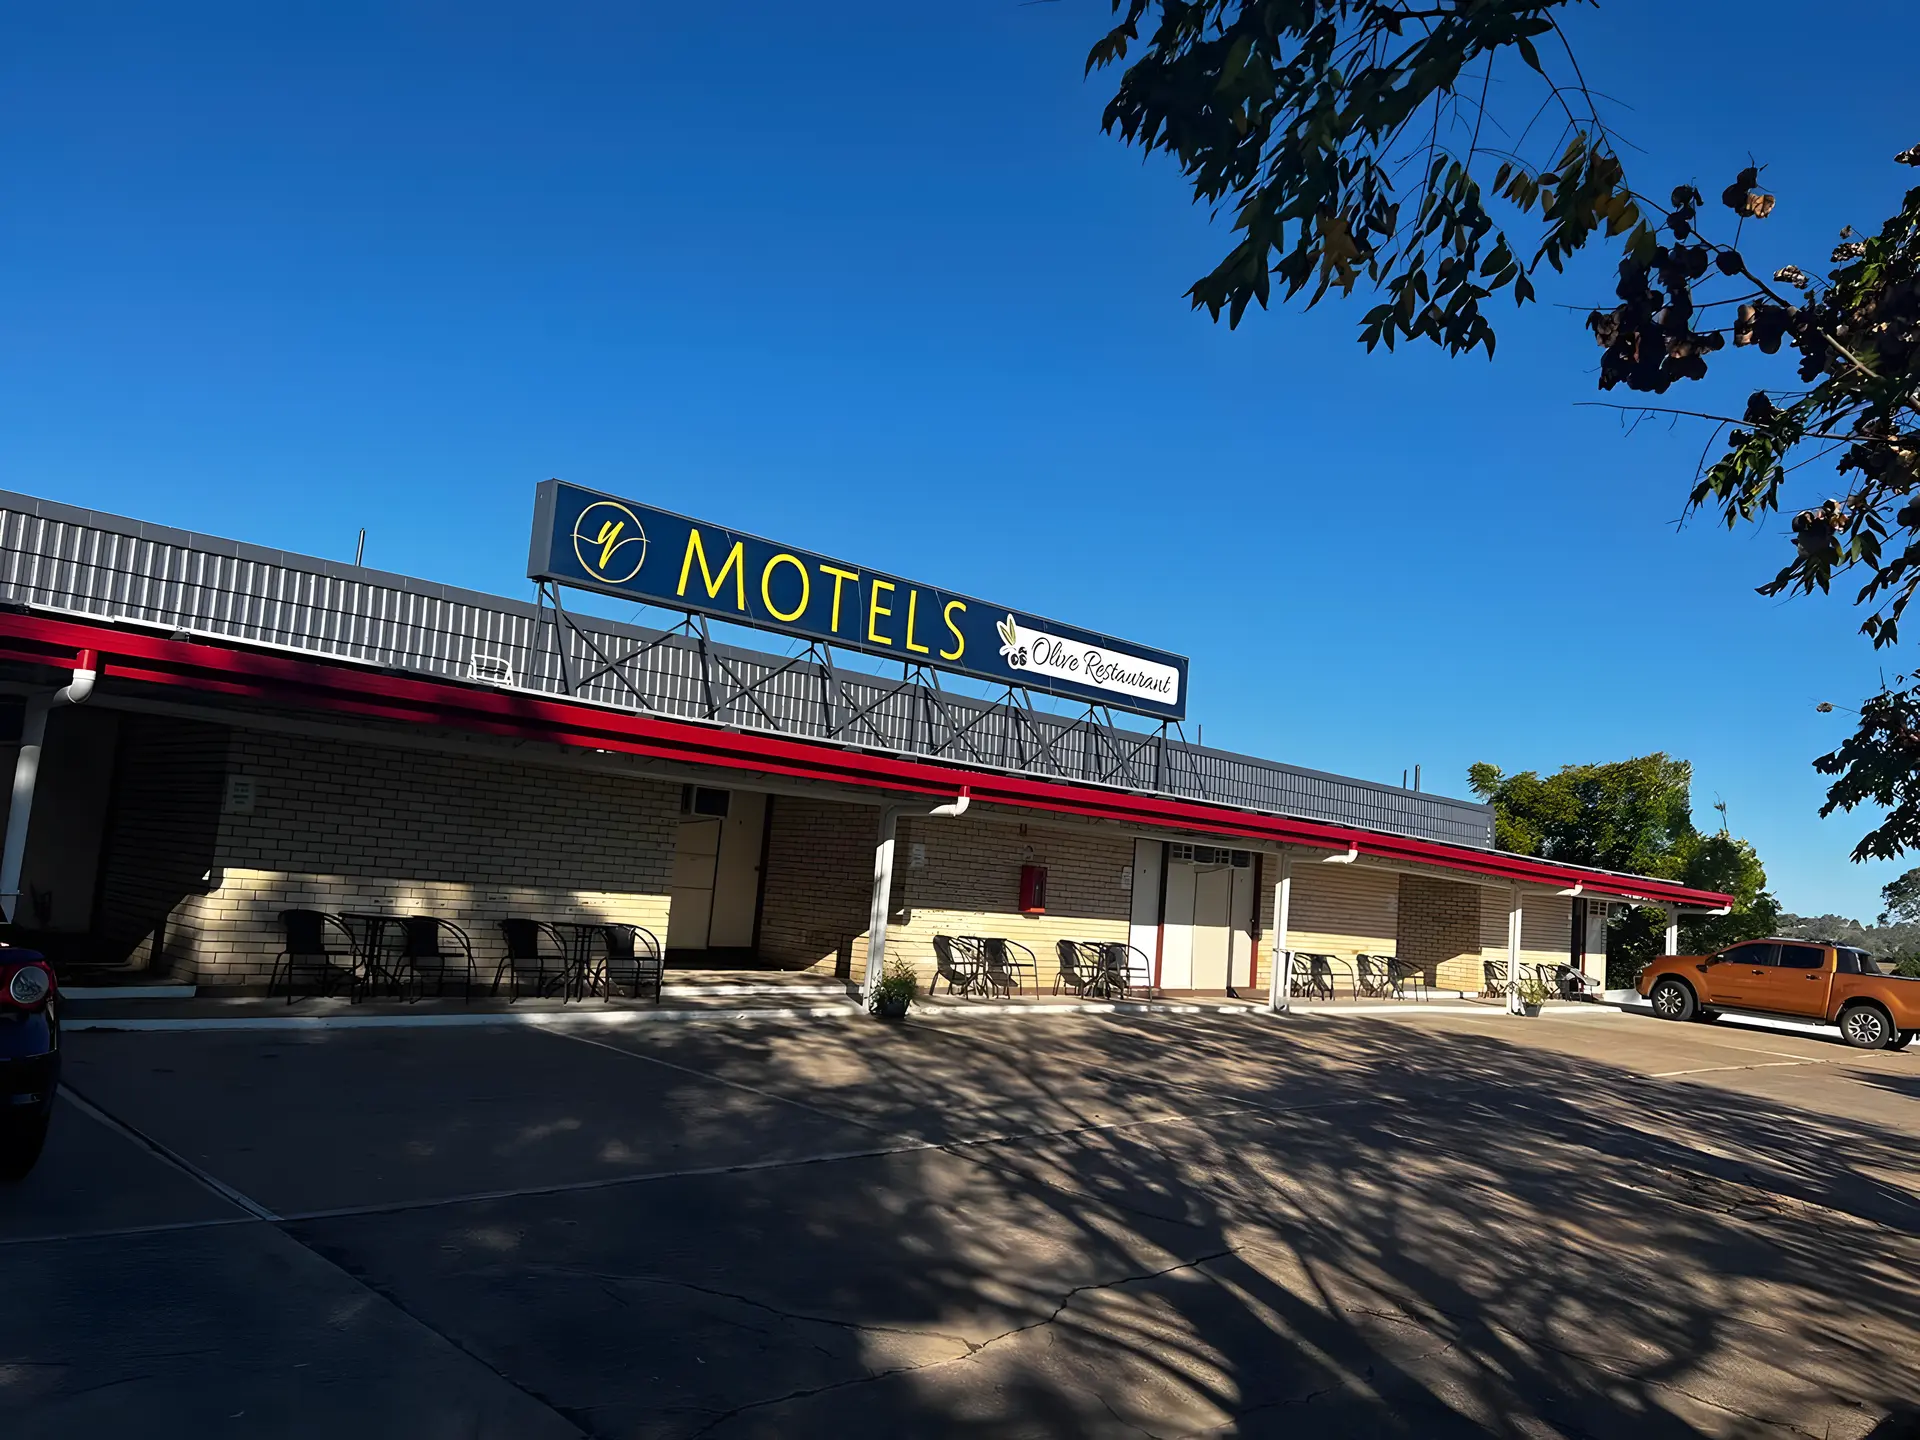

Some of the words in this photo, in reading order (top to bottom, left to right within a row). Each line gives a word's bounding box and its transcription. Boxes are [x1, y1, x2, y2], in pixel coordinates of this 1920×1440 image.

[676, 528, 967, 661] MOTELS
[1031, 637, 1080, 672] Olive
[1083, 650, 1171, 694] Restaurant
